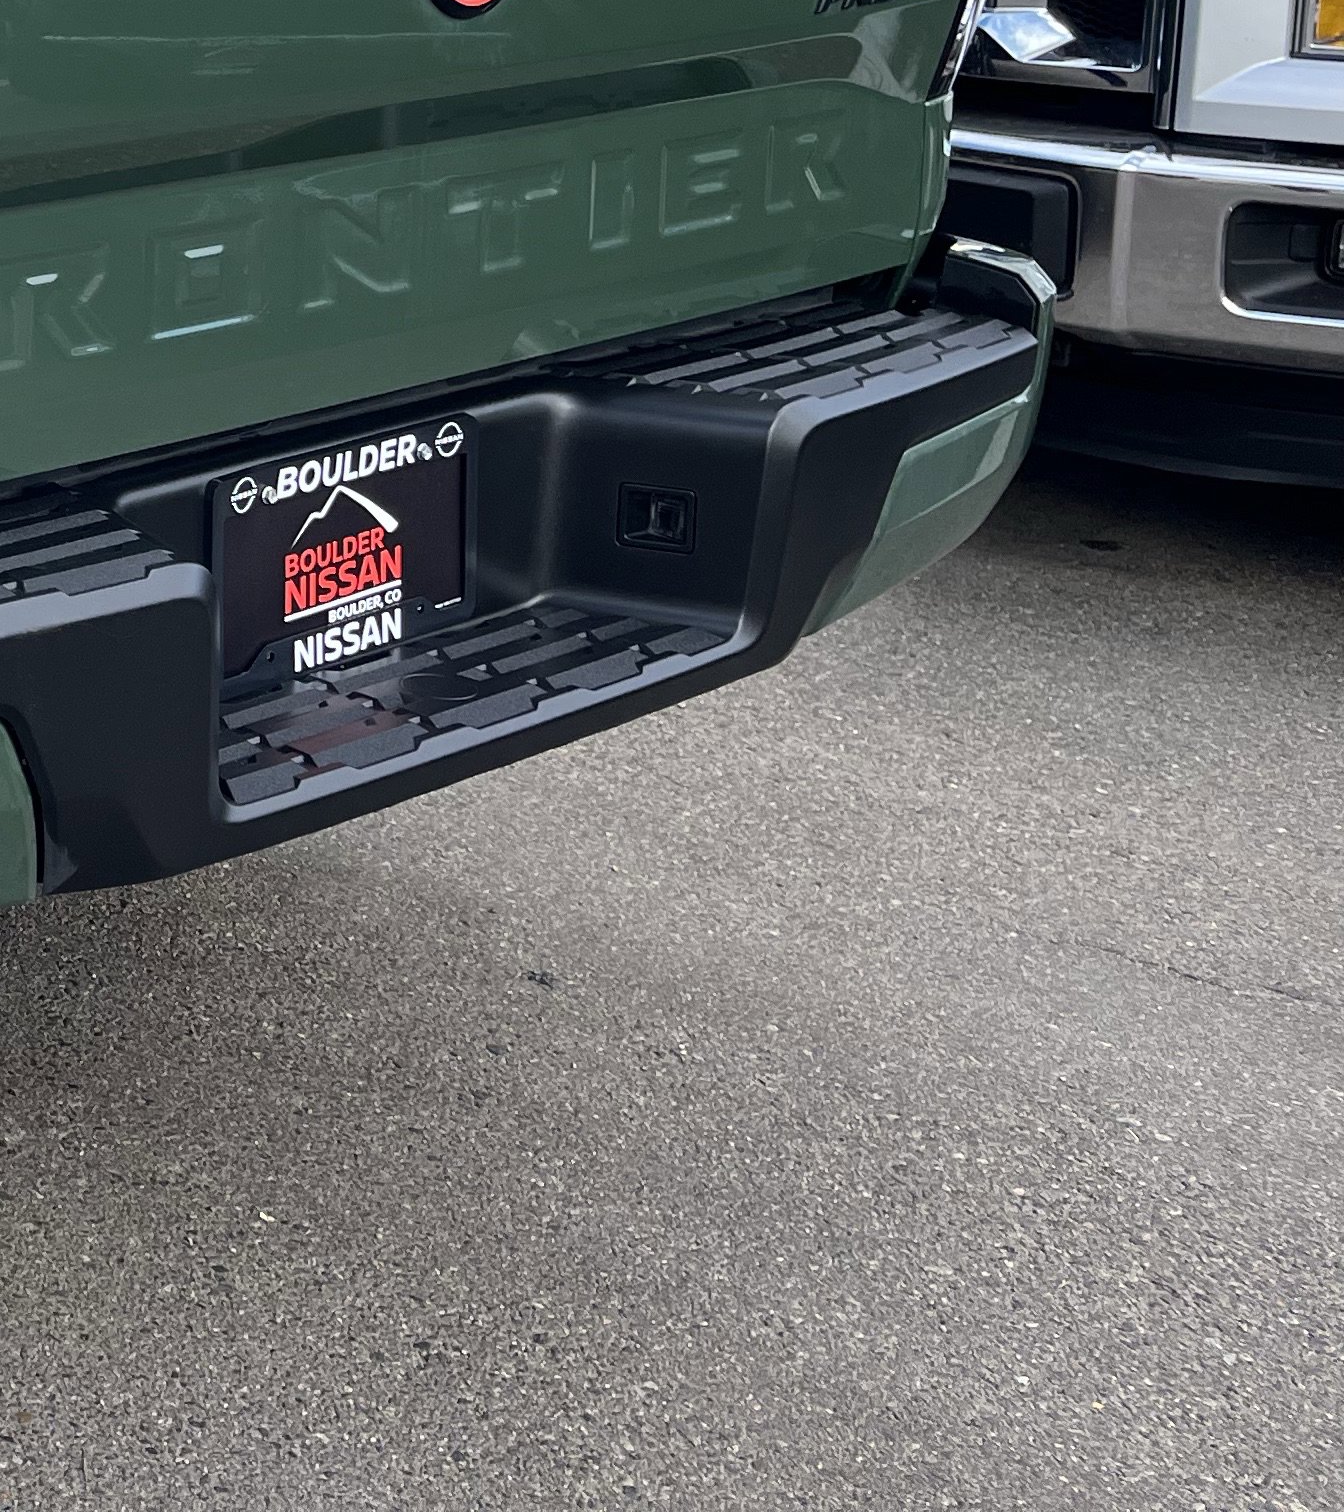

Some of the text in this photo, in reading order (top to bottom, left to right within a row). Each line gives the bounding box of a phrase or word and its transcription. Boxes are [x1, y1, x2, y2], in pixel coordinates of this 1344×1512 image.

[276, 433, 417, 500] BOULDER
[284, 526, 386, 578] BOULDER
[284, 545, 402, 614] NISSAN
[327, 588, 402, 623] BOULDER, CO
[293, 607, 403, 673] NISSAN
